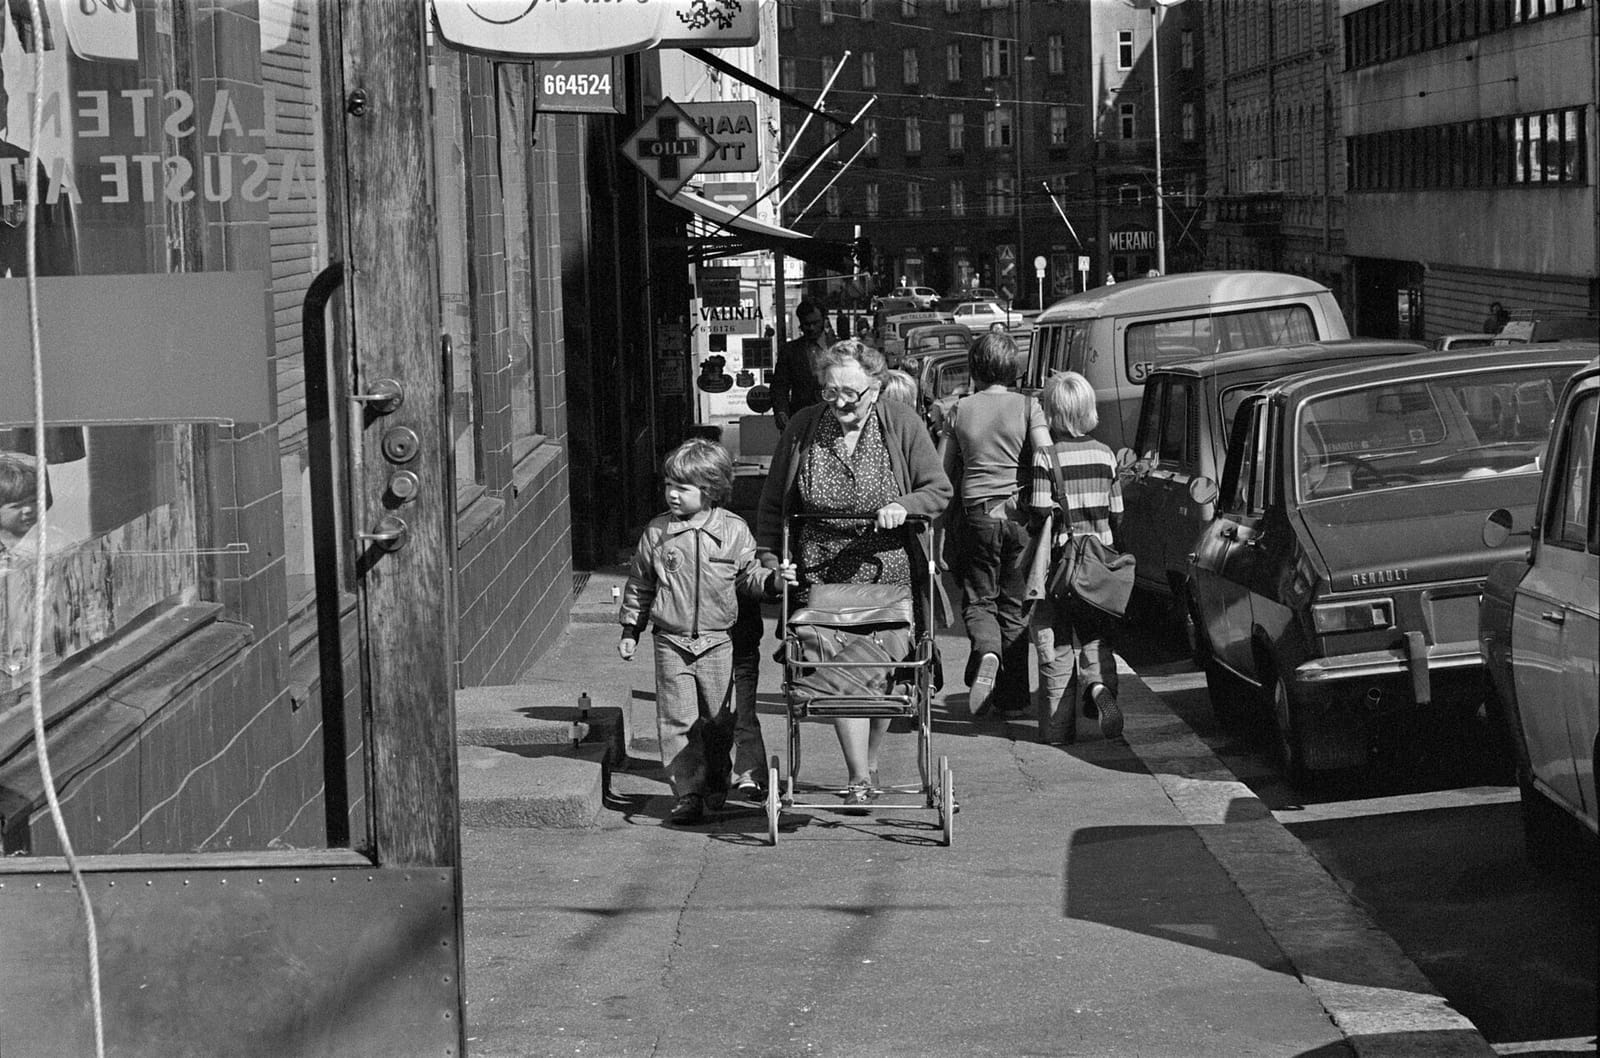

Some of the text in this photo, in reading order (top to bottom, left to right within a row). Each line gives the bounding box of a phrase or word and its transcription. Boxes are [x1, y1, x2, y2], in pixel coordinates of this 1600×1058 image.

[543, 73, 611, 96] 664524
[1109, 231, 1156, 250] MERANO
[699, 305, 764, 321] VALINTA
[1351, 568, 1408, 586] RENAULT
